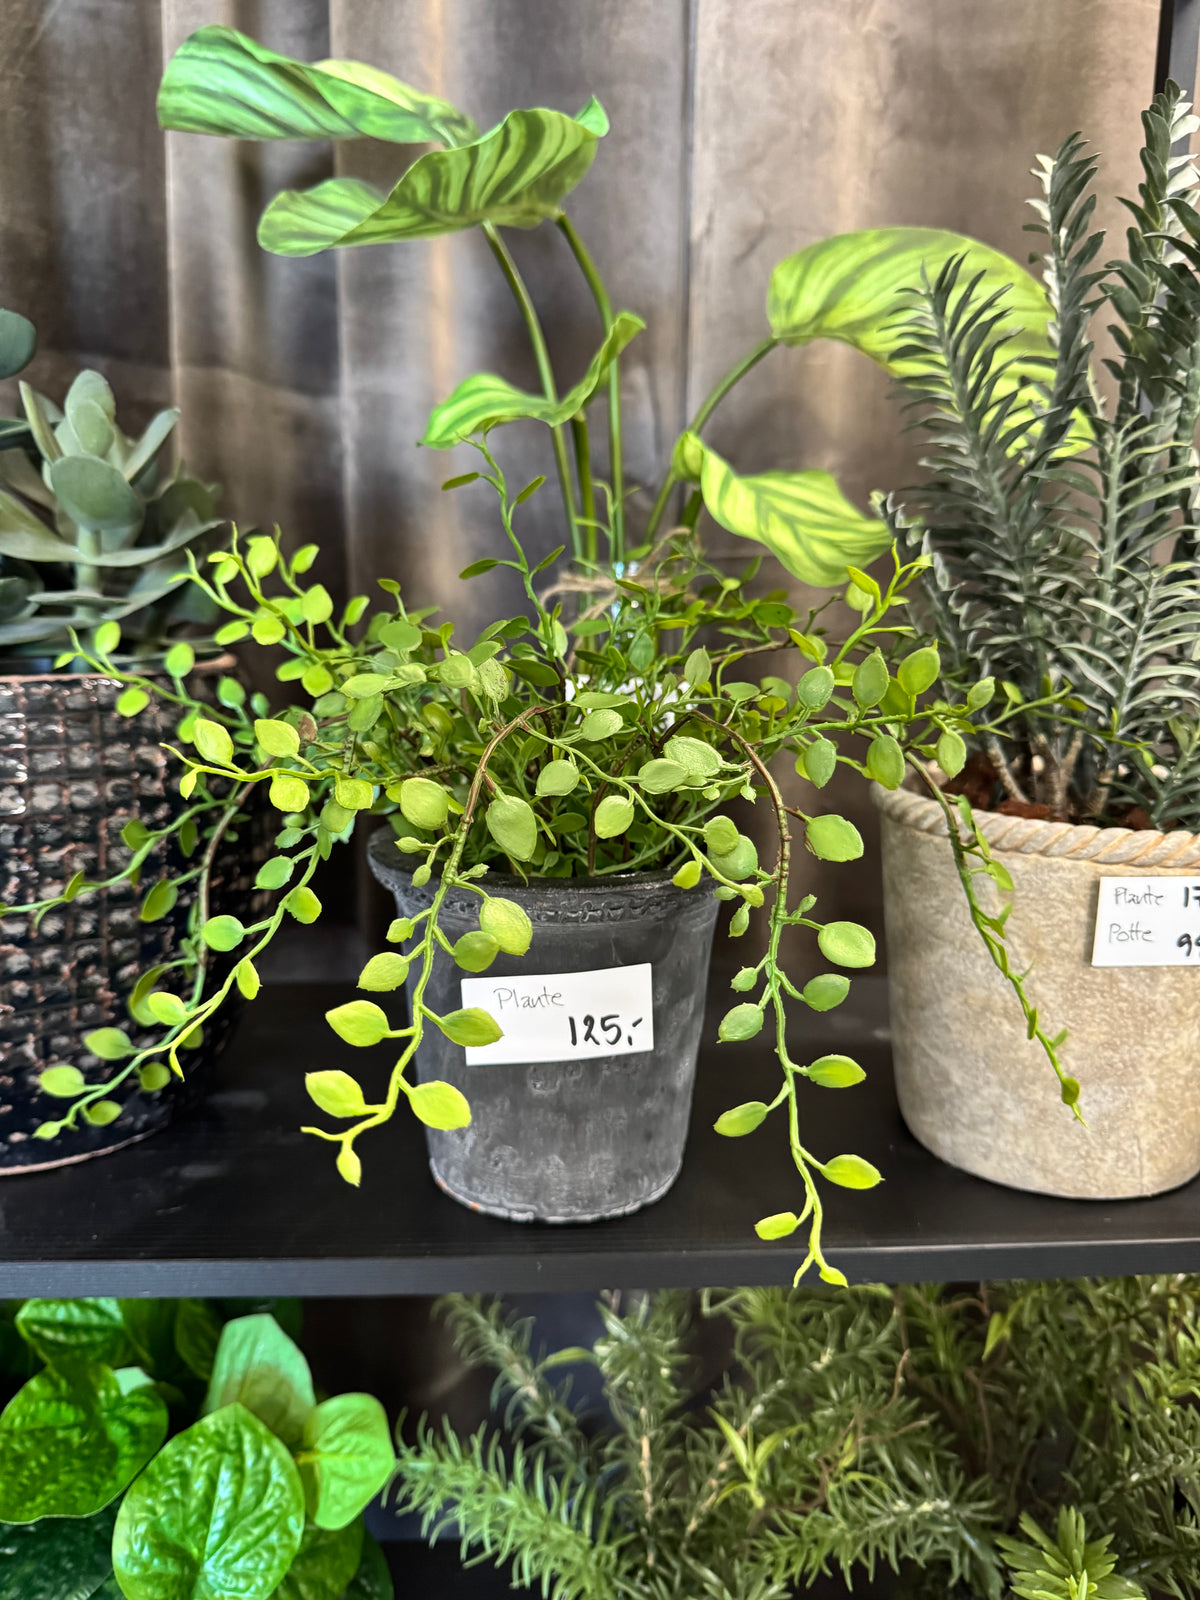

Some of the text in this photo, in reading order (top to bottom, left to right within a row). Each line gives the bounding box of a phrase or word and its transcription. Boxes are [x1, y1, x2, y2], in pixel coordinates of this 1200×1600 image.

[1114, 885, 1164, 905] Plante
[1109, 921, 1153, 943] Potte
[493, 986, 565, 1009] Plante
